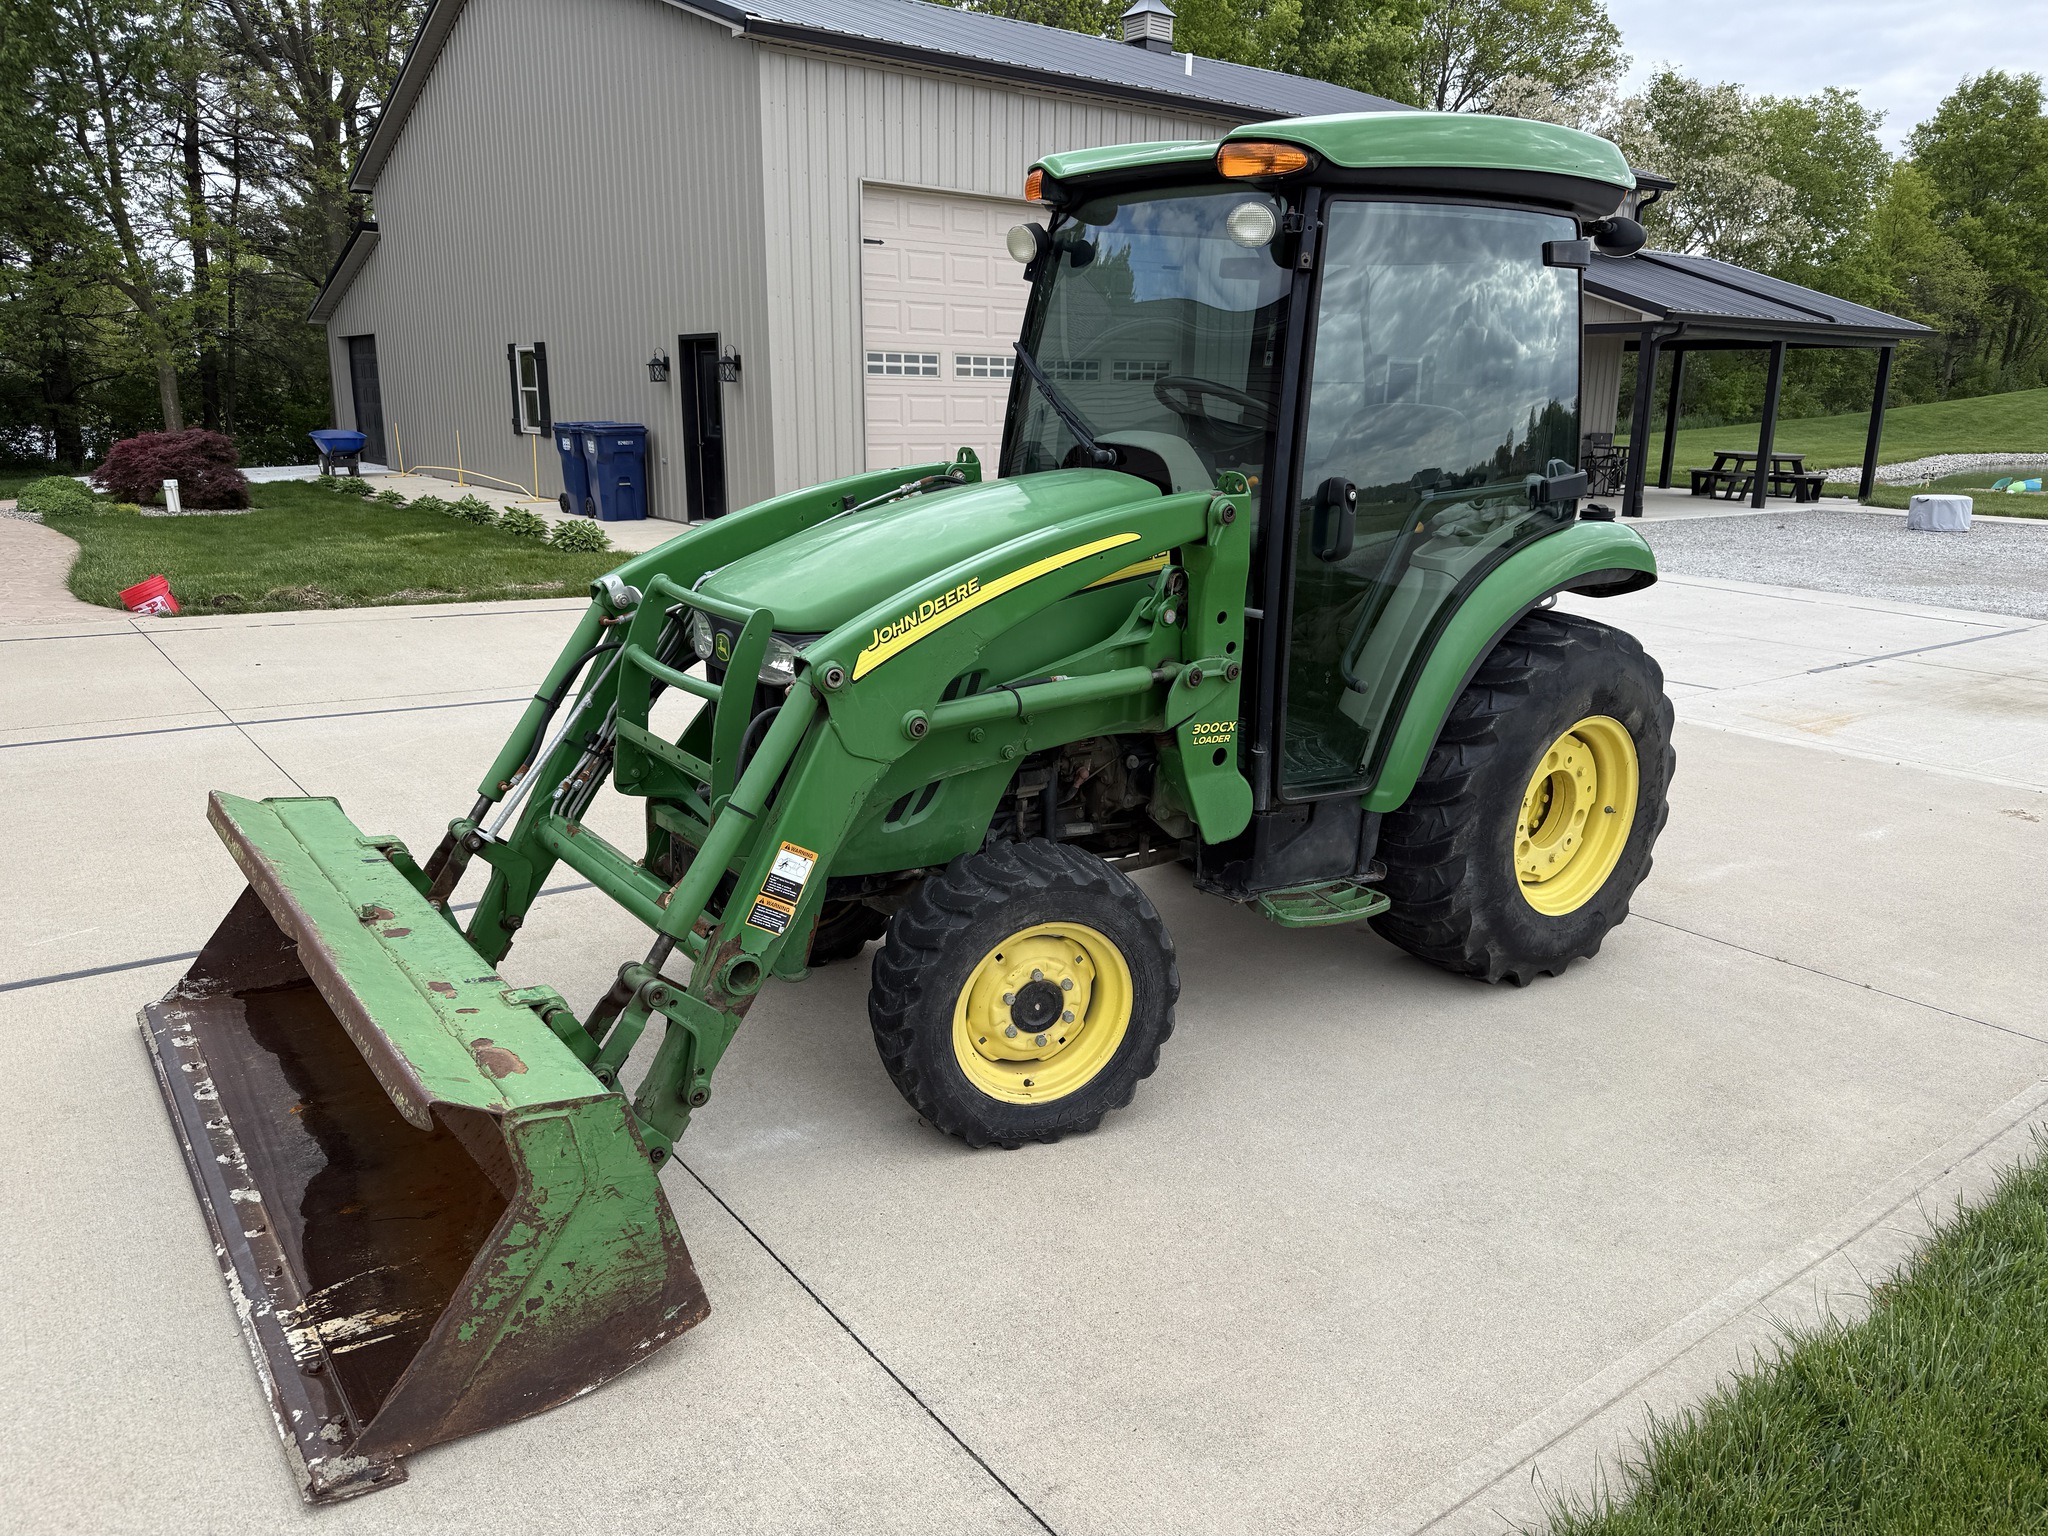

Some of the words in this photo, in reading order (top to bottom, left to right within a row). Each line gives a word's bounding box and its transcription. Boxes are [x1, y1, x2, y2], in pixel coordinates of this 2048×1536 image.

[868, 610, 919, 651] JOHN
[918, 576, 981, 623] DEERE
[1192, 721, 1237, 735] 300CX
[1192, 734, 1231, 745] LOADER
[790, 846, 813, 858] WARNING
[766, 900, 790, 913] WARNING
